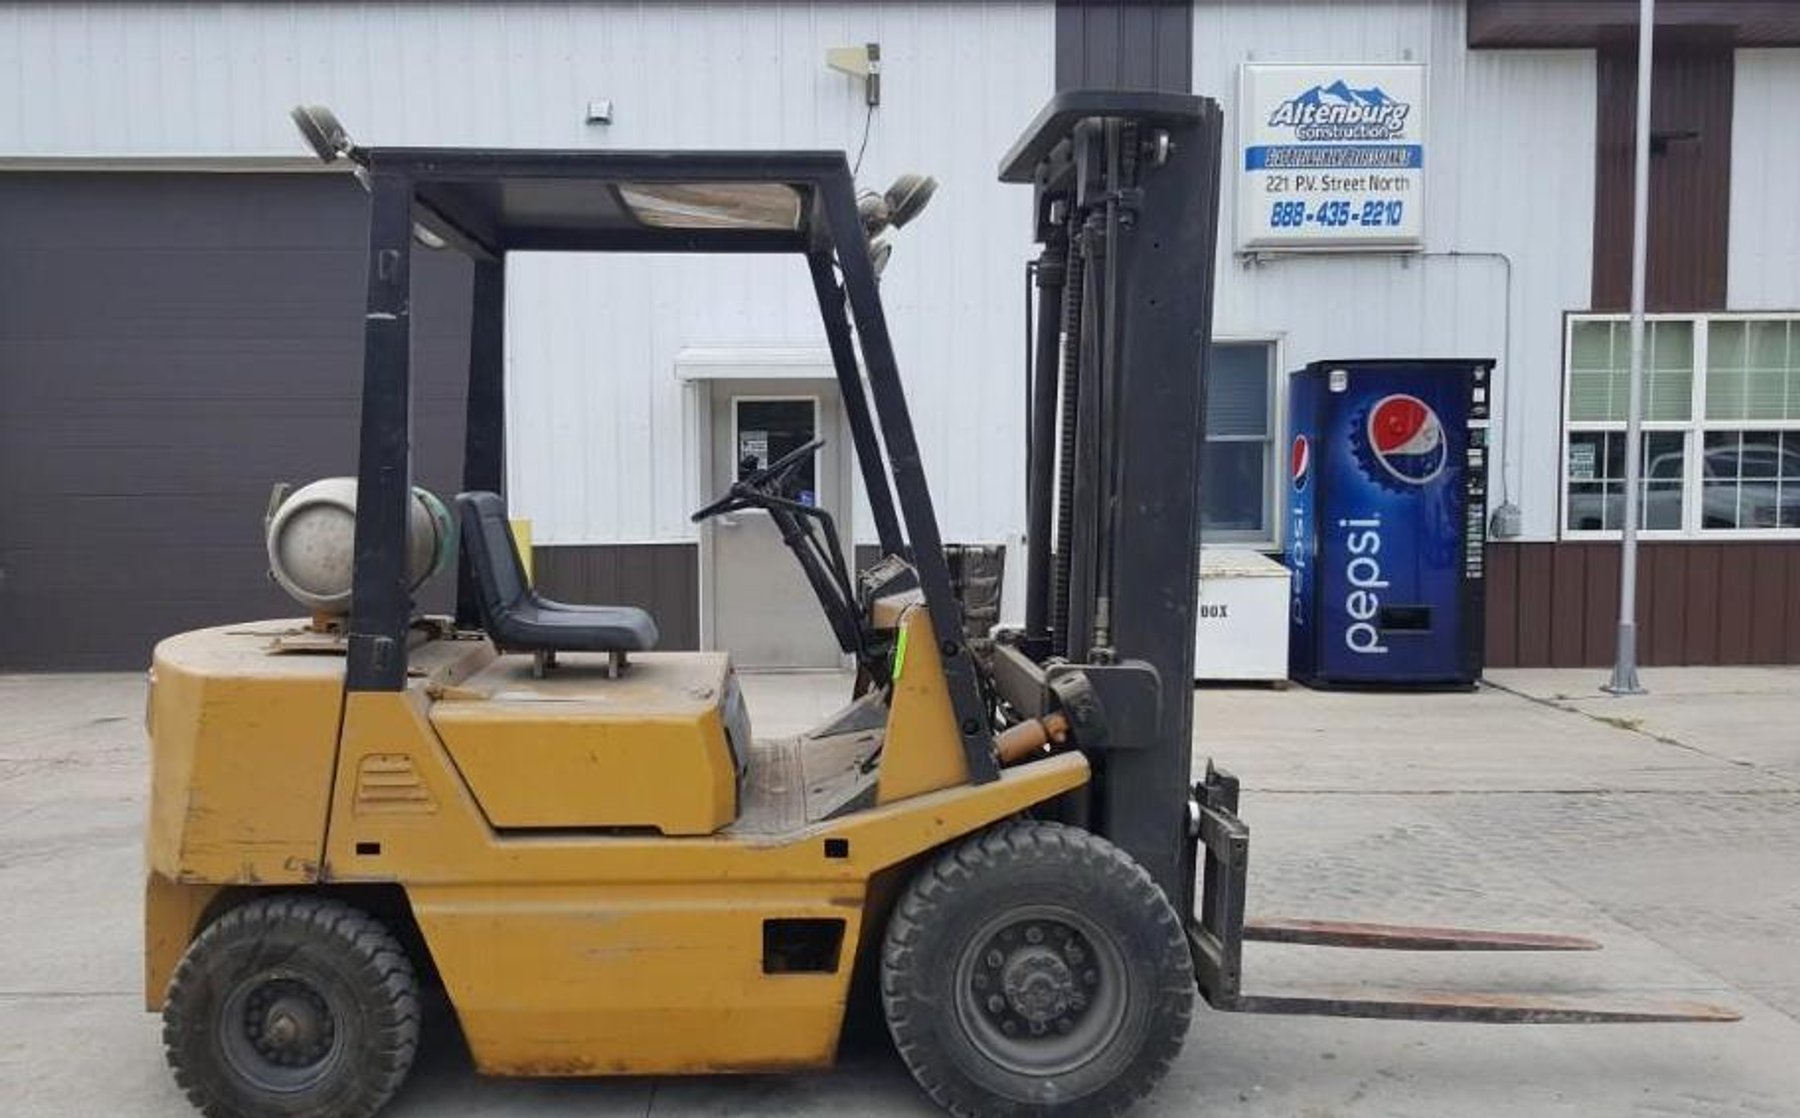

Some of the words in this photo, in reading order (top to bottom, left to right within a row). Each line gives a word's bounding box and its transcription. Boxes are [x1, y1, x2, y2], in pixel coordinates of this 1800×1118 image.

[1268, 101, 1410, 130] Altenburg
[1265, 176, 1290, 192] 221
[1322, 175, 1365, 191] Street
[1369, 175, 1411, 191] North
[1339, 518, 1390, 654] pepsi
